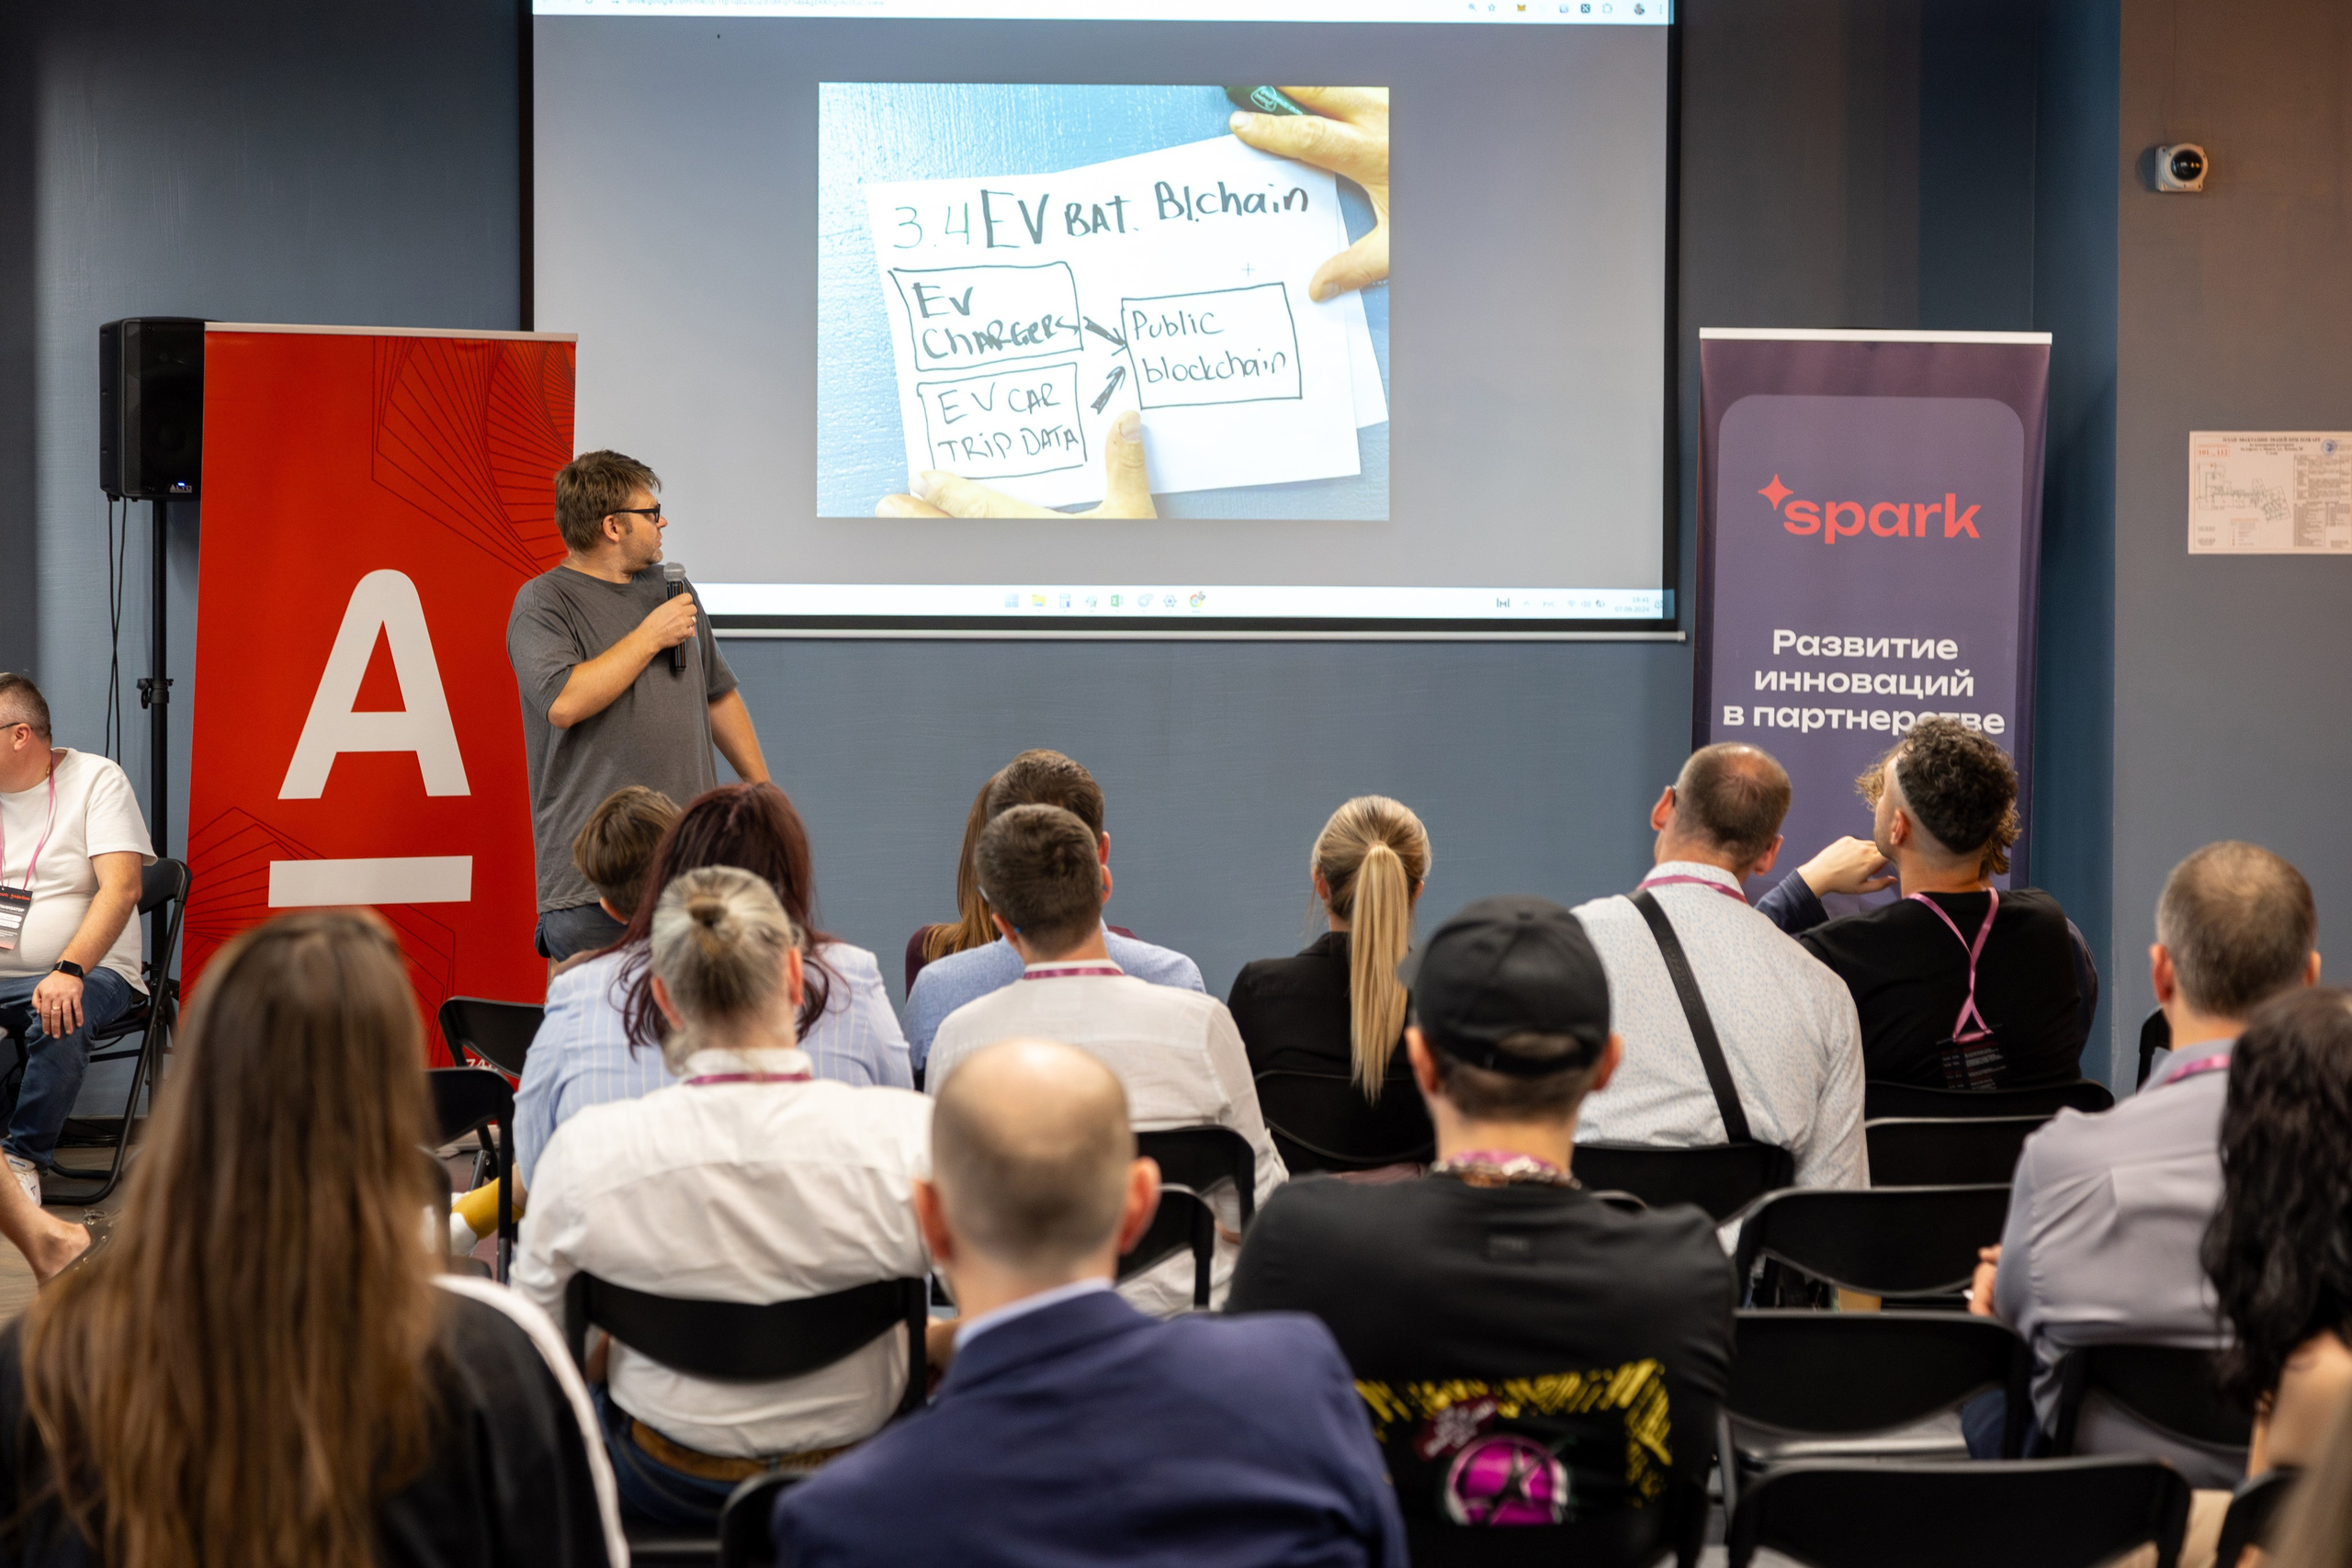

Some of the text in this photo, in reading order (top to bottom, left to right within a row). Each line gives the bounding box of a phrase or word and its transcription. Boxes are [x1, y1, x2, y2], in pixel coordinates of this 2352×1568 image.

[894, 201, 969, 249] 3.4
[980, 189, 1049, 249] EV
[1141, 347, 1286, 384] blockchain
[937, 381, 1061, 424] EV CAR
[1019, 424, 1080, 456] DATA
[1783, 492, 1982, 545] spark
[1772, 628, 1959, 660] Развитие
[1754, 667, 1974, 699] инноваций
[1723, 705, 1745, 726] в
